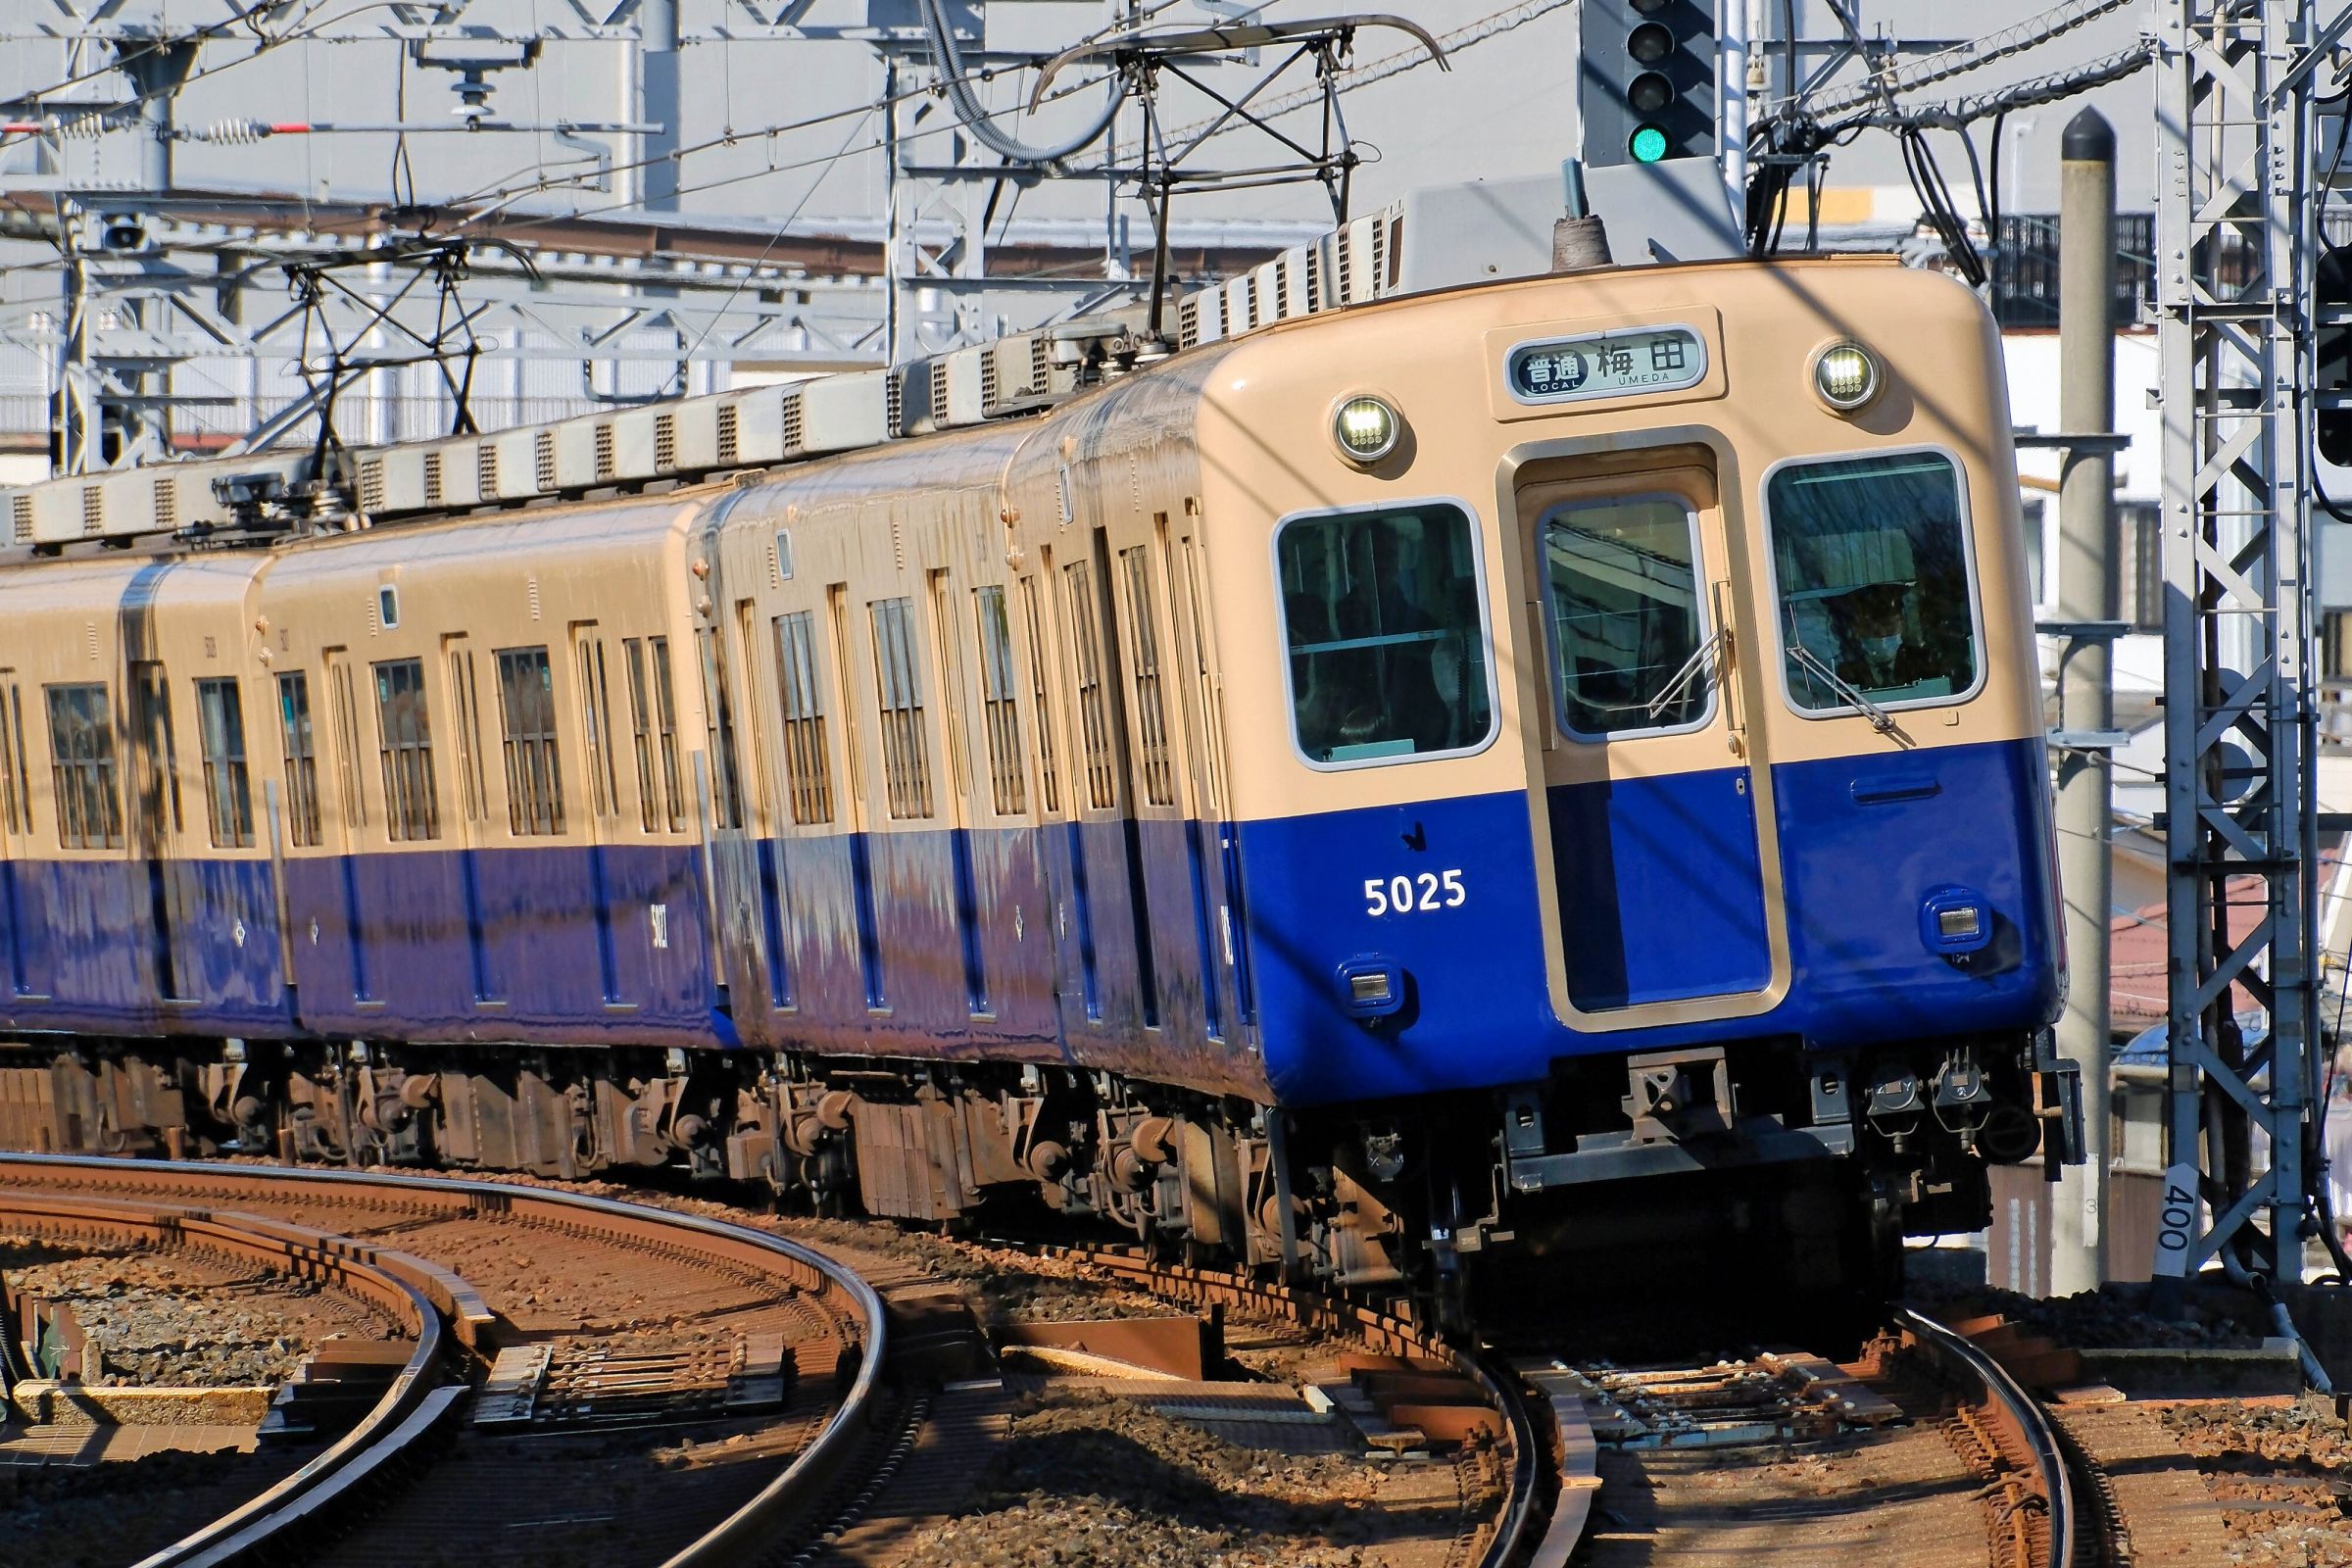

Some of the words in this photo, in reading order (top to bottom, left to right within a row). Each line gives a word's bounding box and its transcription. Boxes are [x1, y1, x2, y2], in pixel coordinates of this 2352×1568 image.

[1527, 350, 1581, 383] 普通
[1596, 338, 1686, 377] 梅田
[1530, 381, 1581, 393] LOCAL
[1618, 372, 1670, 386] UMEDA
[1364, 868, 1466, 916] 5025
[2158, 1185, 2194, 1251] 400
